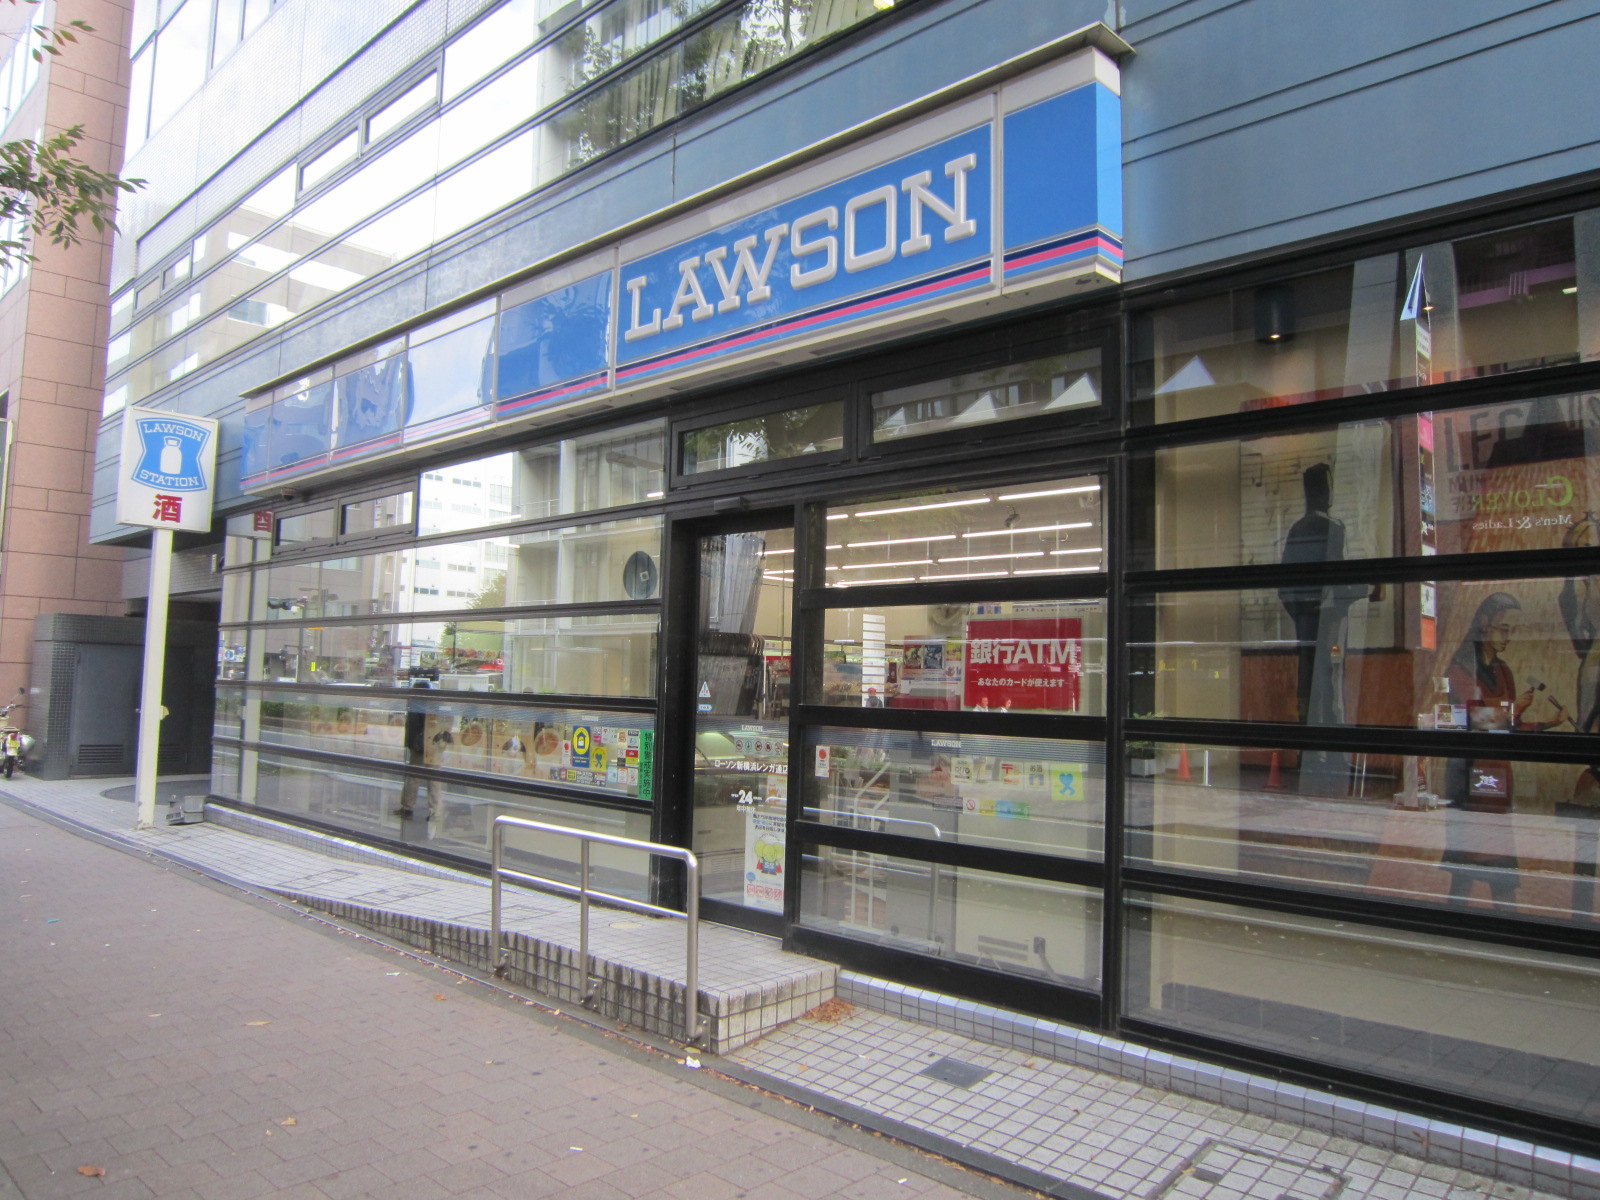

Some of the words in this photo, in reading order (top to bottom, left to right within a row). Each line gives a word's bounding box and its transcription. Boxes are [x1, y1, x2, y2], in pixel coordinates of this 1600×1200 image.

[625, 152, 976, 343] LAWSON
[143, 423, 204, 442] LAWSON
[139, 469, 200, 487] STATION
[152, 493, 183, 523] 酒
[970, 637, 1077, 665] 銀行ATM
[977, 677, 1065, 688] あなたのカードが使えます
[931, 739, 961, 748] LAWSON
[738, 789, 754, 804] 24
